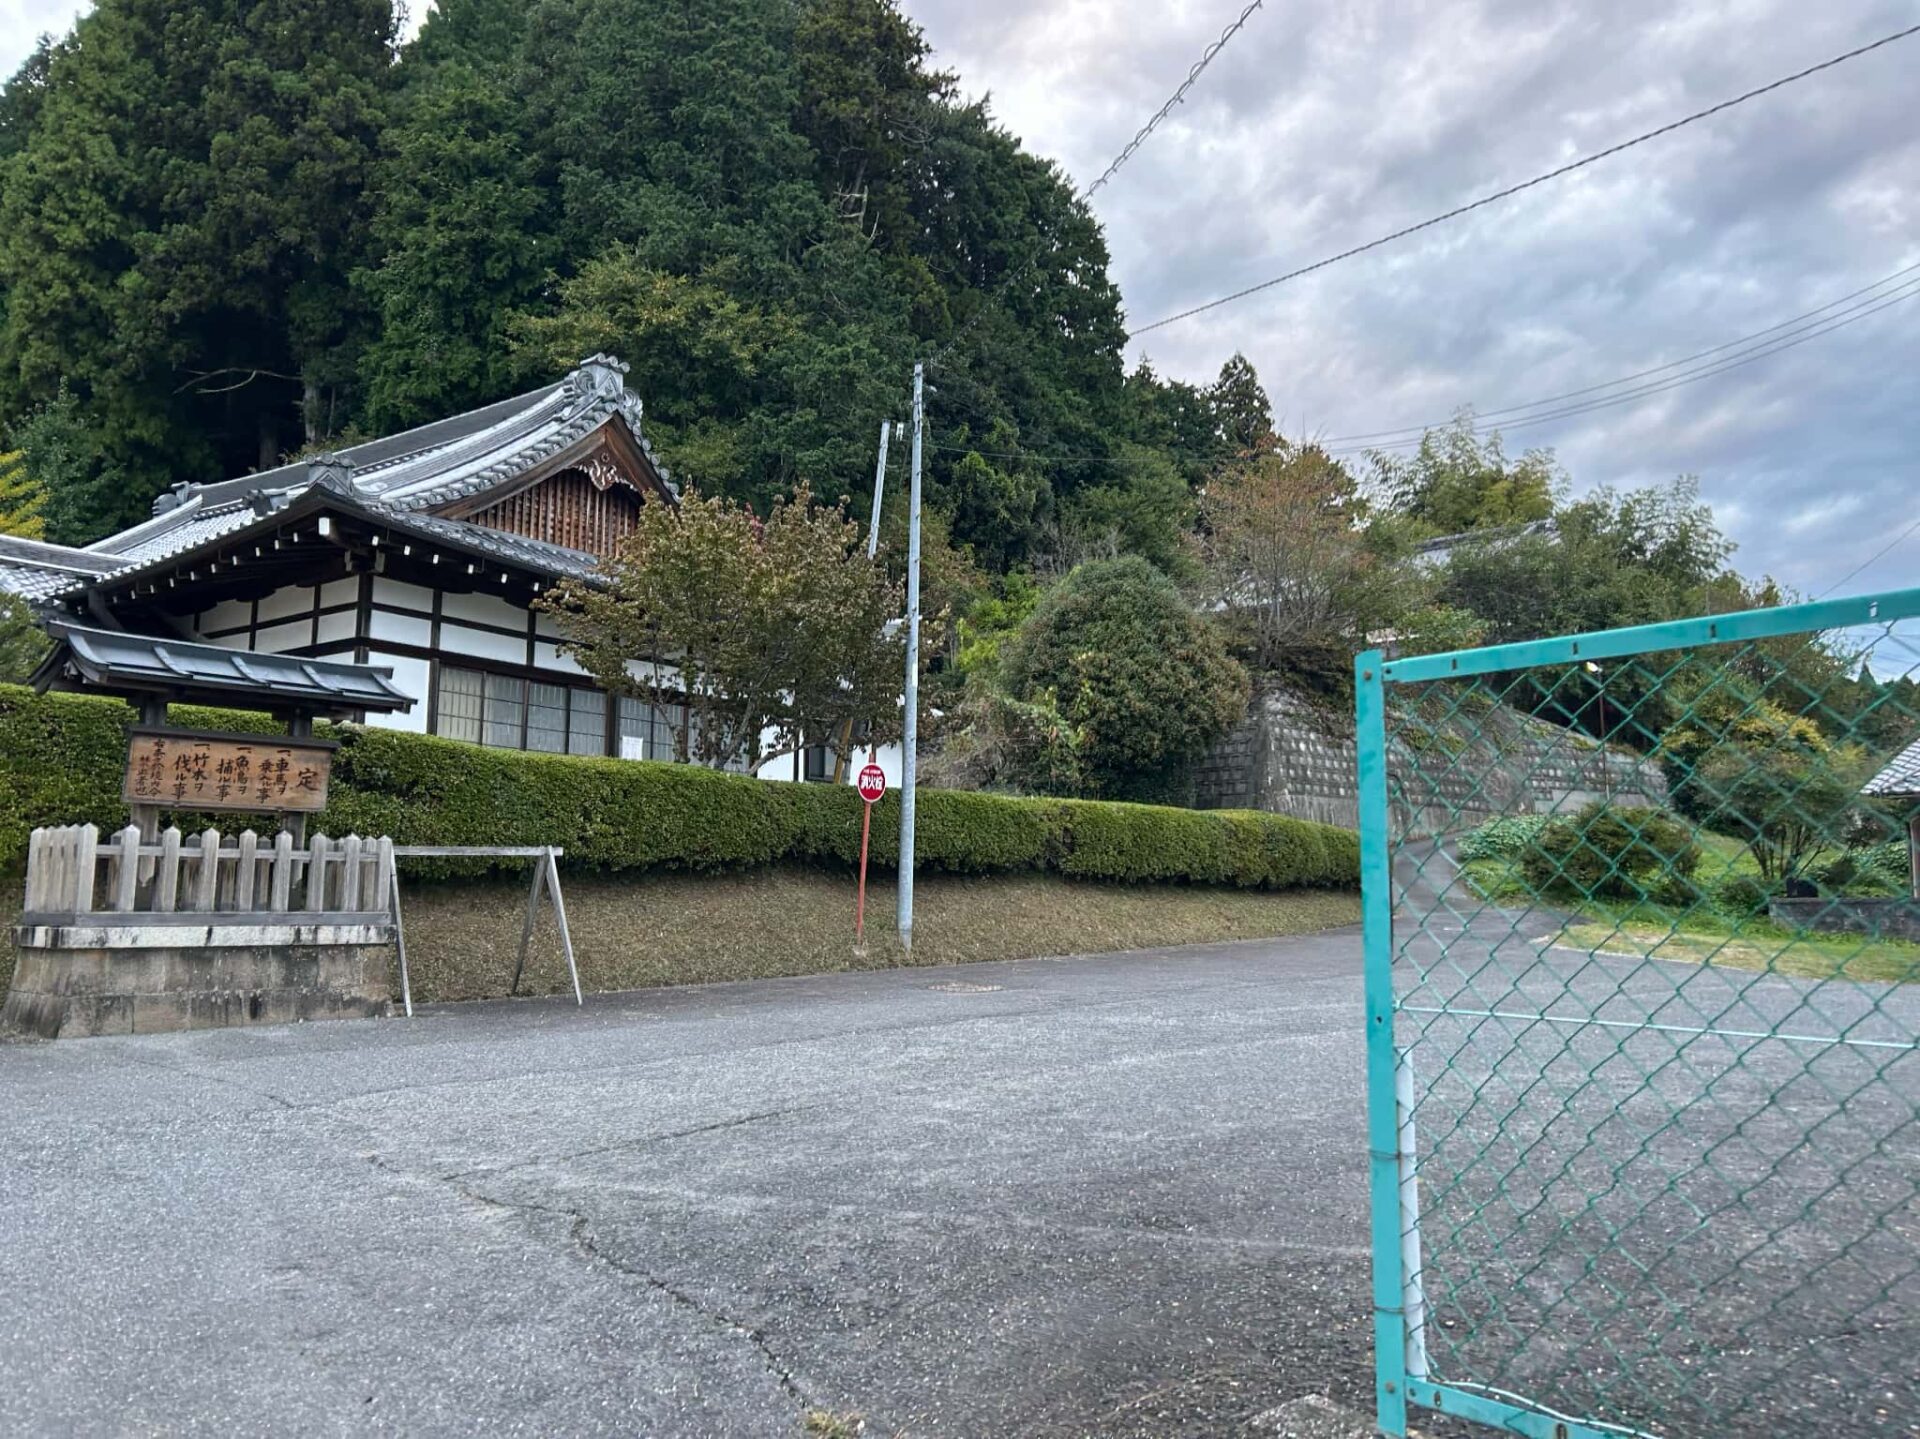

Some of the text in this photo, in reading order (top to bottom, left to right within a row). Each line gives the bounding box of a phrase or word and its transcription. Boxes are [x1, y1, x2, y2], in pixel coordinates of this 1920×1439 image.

[296, 767, 320, 791] 定
[860, 774, 884, 791] 消火栓
